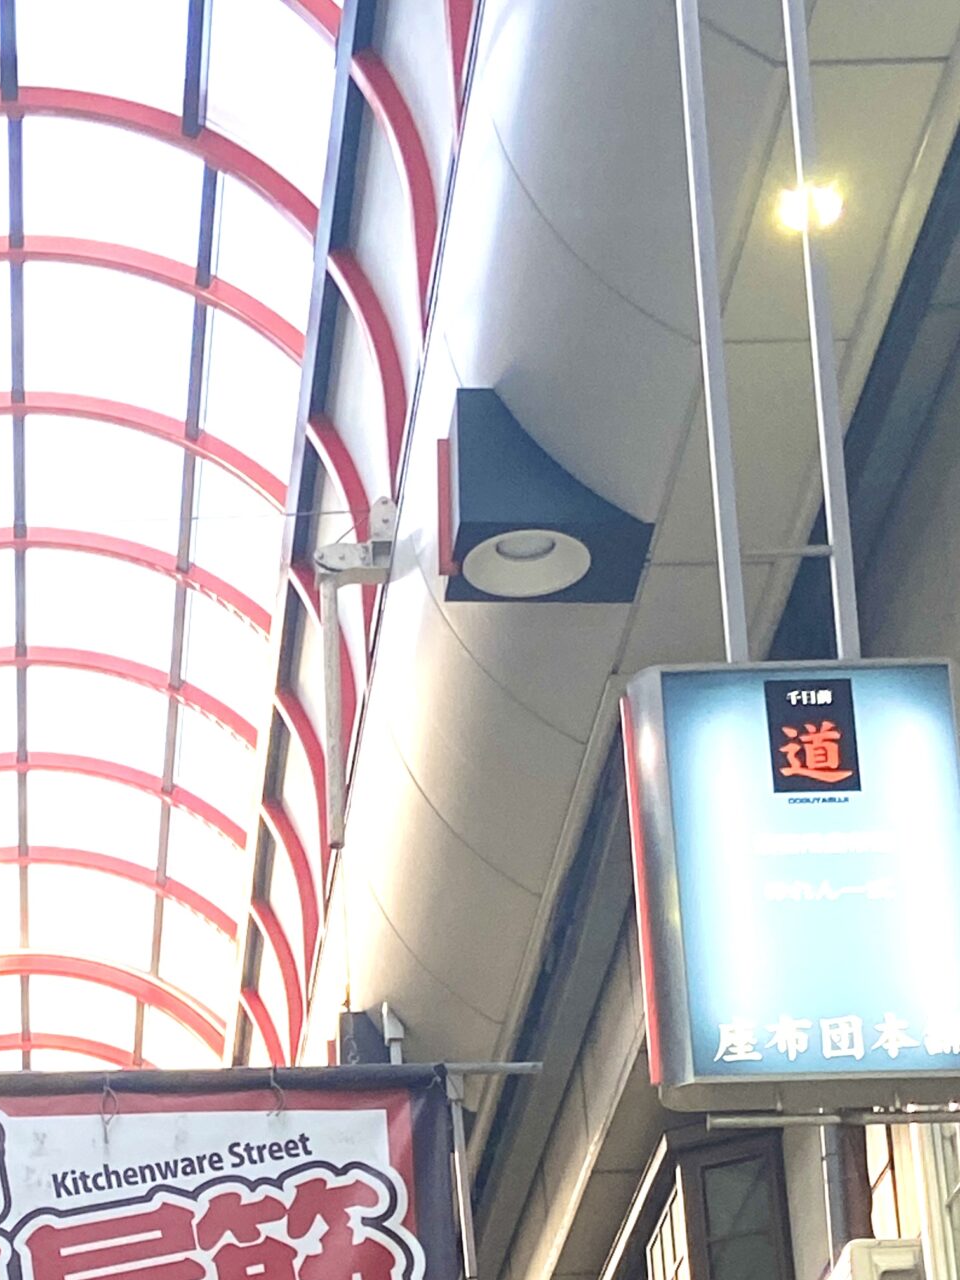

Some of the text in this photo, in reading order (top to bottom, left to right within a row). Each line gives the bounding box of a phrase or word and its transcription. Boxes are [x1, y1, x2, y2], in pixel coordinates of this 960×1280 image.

[778, 720, 854, 784] 道
[52, 1132, 313, 1199] Kitchenware Street
